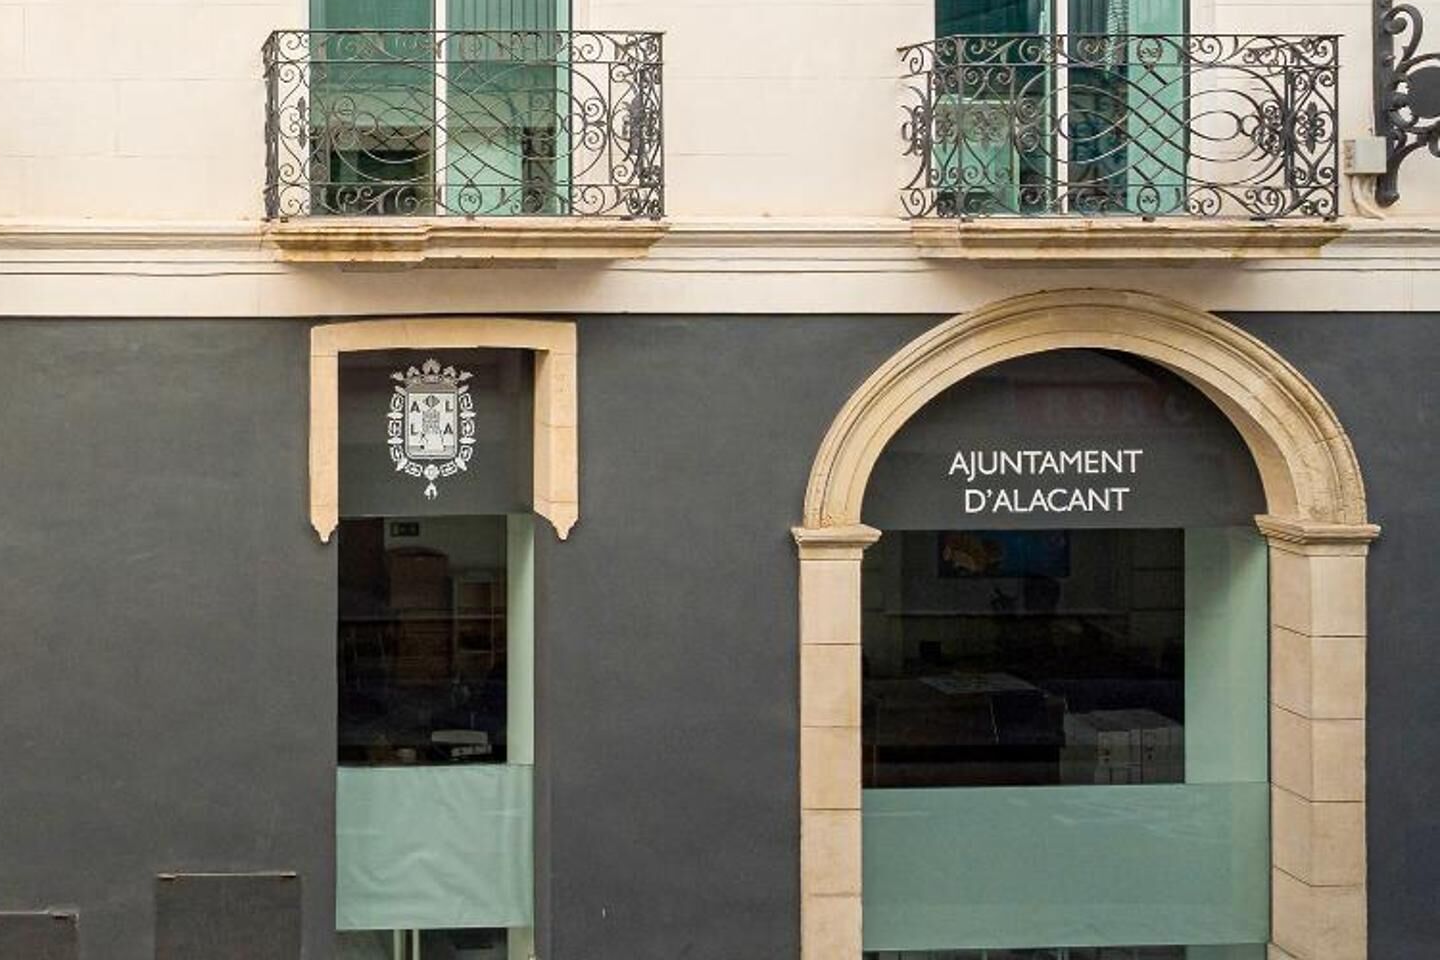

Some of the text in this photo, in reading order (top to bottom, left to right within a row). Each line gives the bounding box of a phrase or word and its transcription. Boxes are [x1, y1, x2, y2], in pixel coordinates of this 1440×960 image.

[410, 400, 454, 413] A L
[410, 422, 454, 435] L A
[949, 449, 1143, 481] AJUNTAMENT
[964, 487, 1130, 513] D'ALACANT
